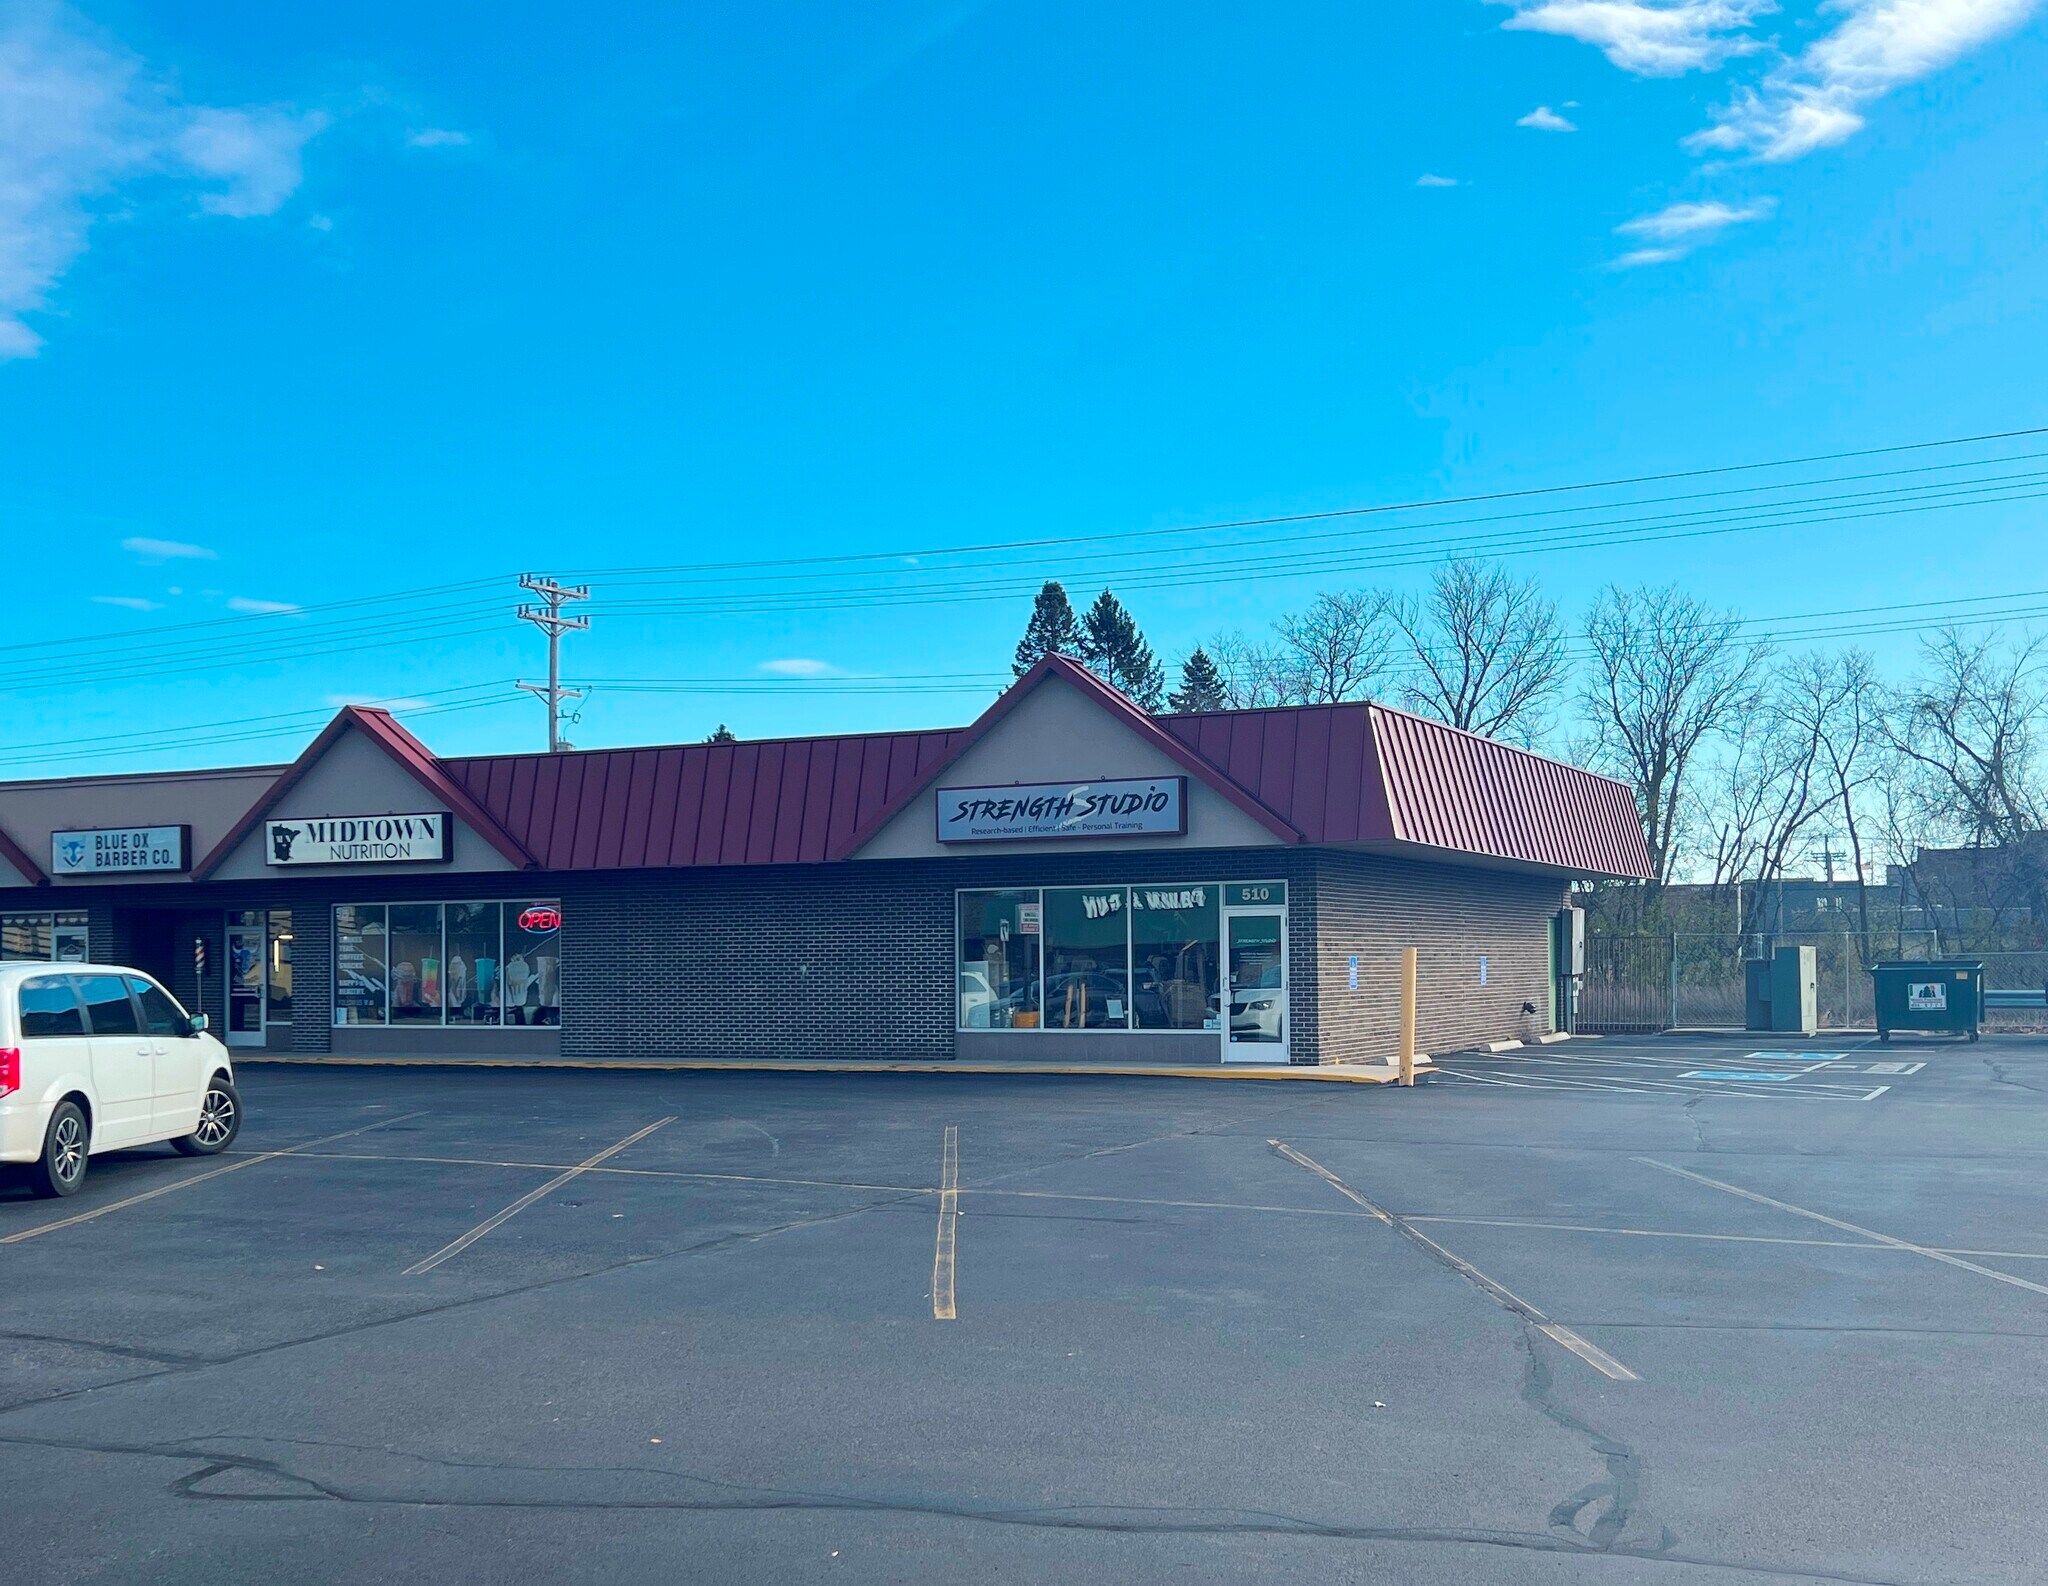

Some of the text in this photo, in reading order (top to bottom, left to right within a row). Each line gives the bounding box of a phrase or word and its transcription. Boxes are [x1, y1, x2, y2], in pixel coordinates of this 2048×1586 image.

[949, 794, 1075, 824] STRENGTH
[305, 817, 437, 843] MIDTOWN
[971, 826, 1024, 835] Research-based
[1082, 822, 1113, 831] Personal
[1114, 821, 1143, 830] Training
[95, 833, 149, 850] BLUE OX
[95, 849, 174, 867] BARBER CO.
[330, 843, 410, 860] NUTRITION
[1241, 887, 1270, 901] 510
[519, 912, 561, 928] OPEN
